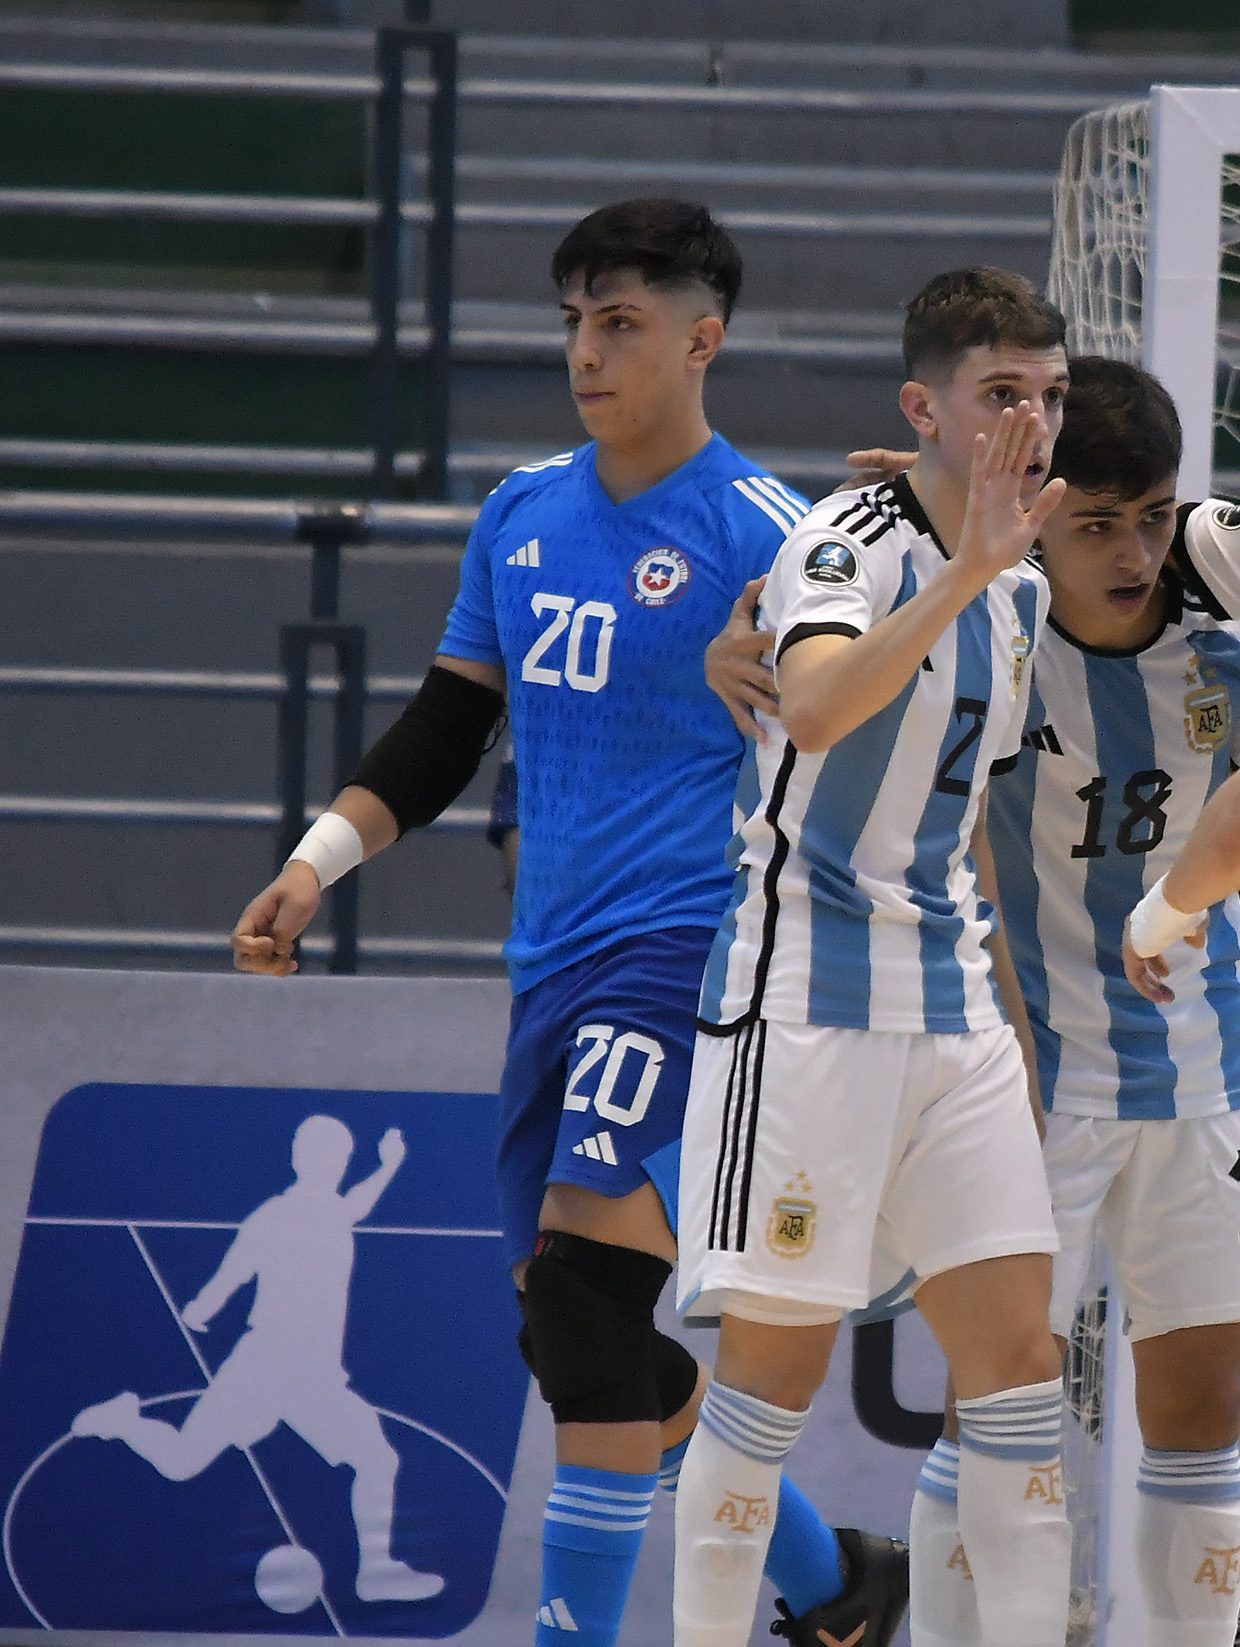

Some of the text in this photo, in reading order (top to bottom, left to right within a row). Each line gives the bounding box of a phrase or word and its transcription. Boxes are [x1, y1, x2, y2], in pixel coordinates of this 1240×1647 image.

[521, 592, 618, 693] 20
[935, 696, 987, 797] 2
[1070, 768, 1173, 859] 18
[564, 1024, 666, 1127] 20
[1024, 1462, 1063, 1506] AF
